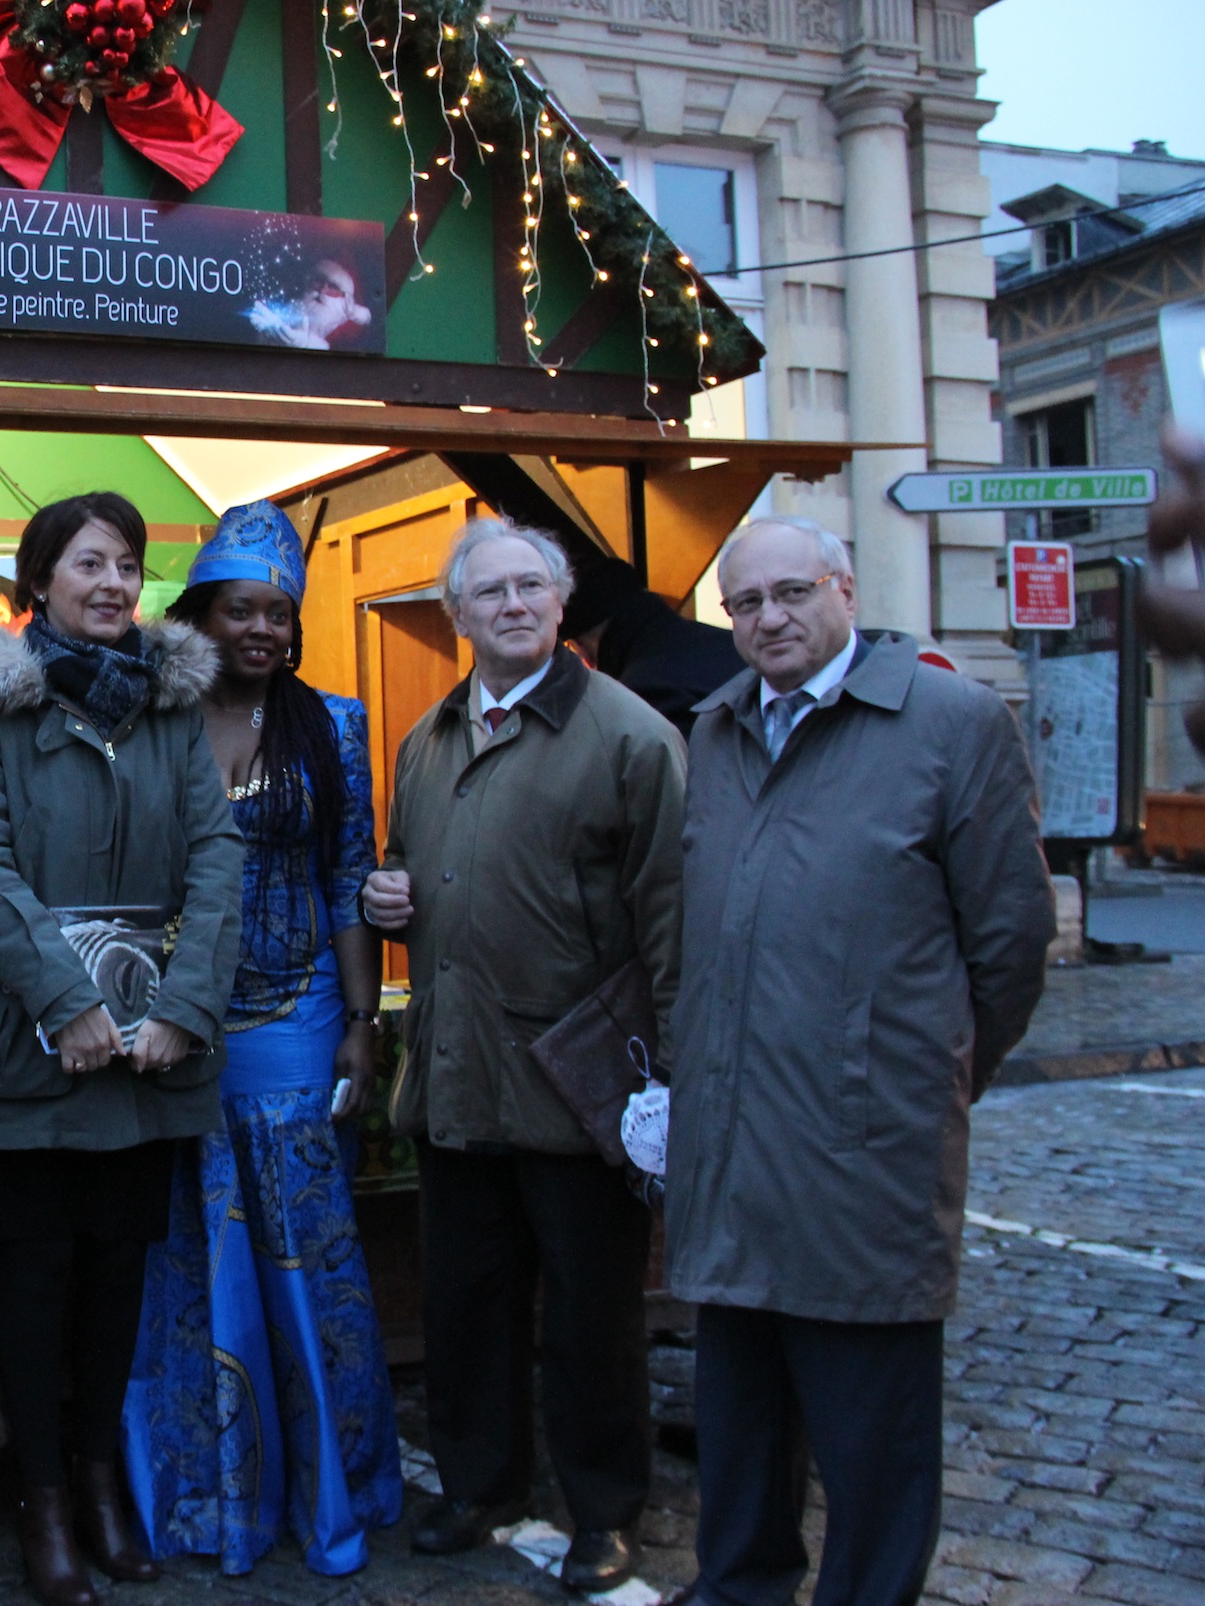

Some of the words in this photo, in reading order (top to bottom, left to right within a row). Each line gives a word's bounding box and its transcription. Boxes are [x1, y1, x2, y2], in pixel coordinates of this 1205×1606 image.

[82, 247, 127, 285] DU
[135, 252, 243, 295] CONGO
[12, 290, 90, 324] peintre.
[95, 293, 179, 326] Peinture
[953, 482, 969, 500] P
[983, 479, 1045, 500] Hôtel
[1054, 479, 1082, 498] de
[1092, 477, 1144, 498] Ville
